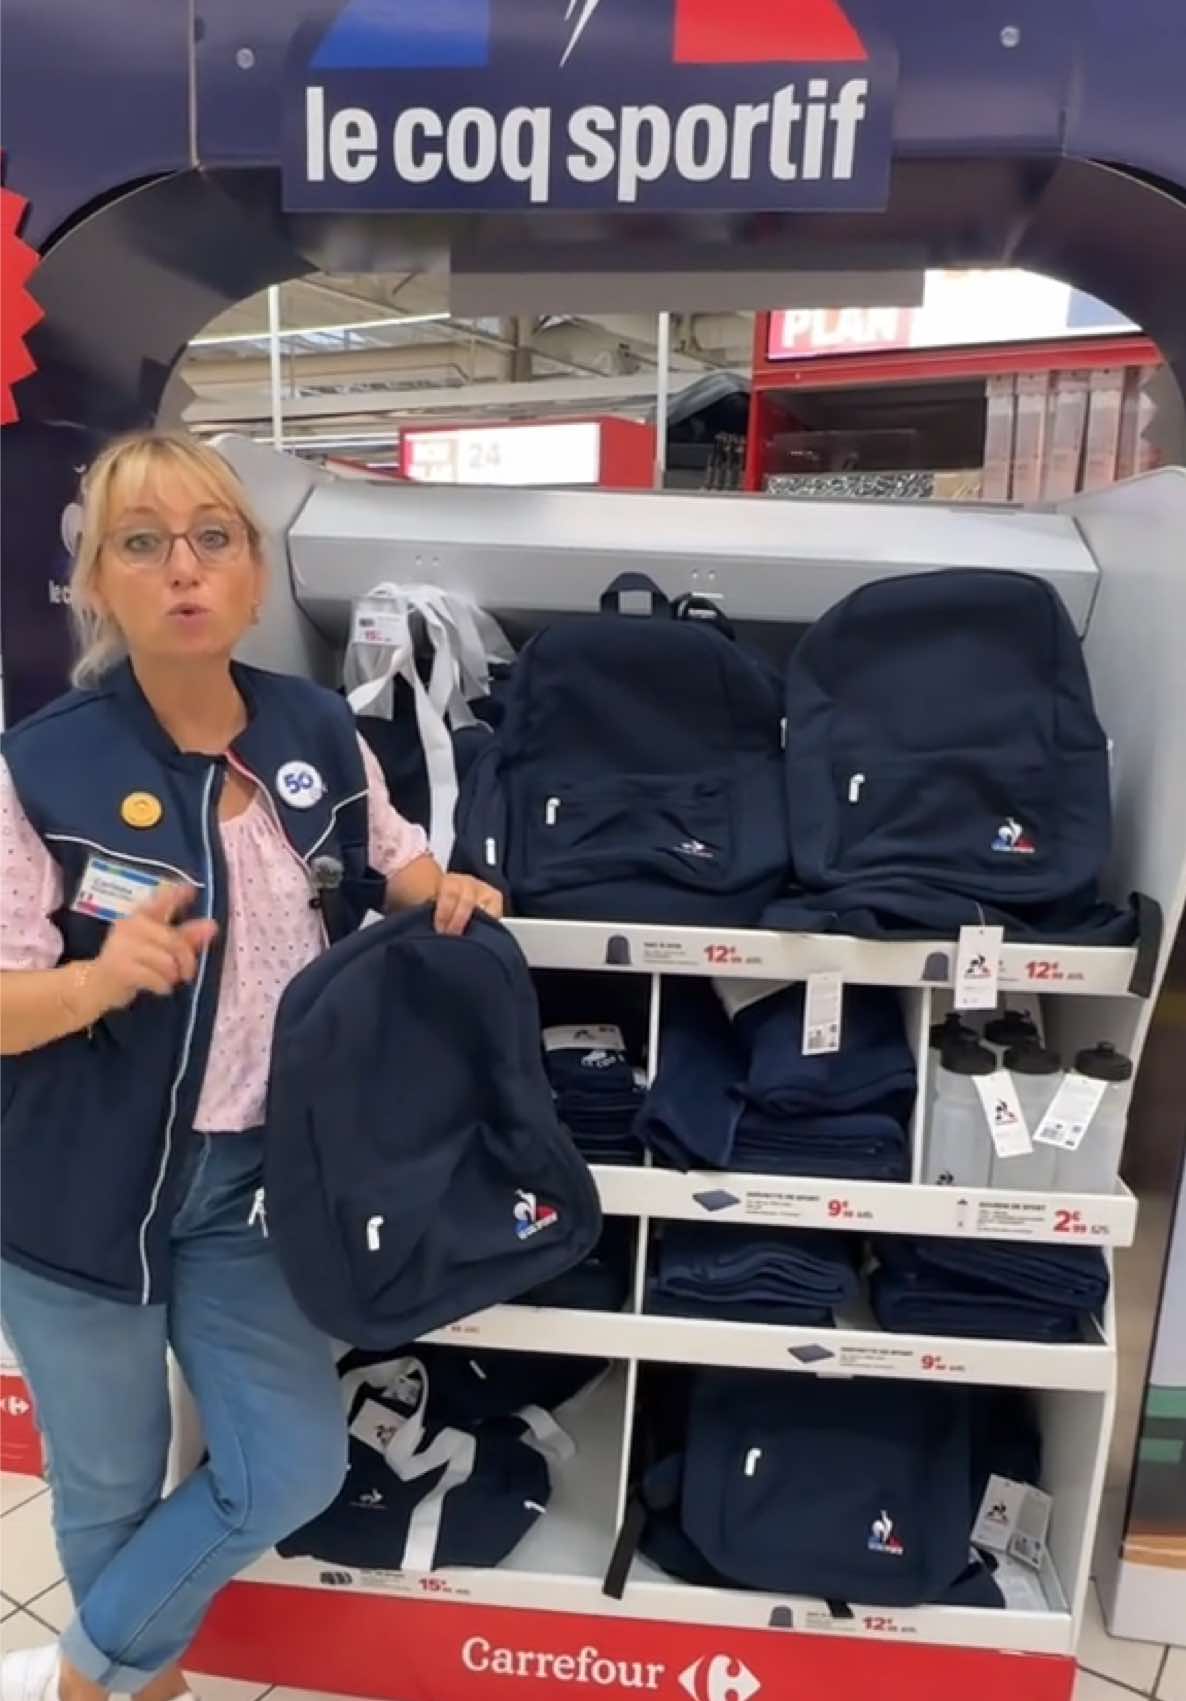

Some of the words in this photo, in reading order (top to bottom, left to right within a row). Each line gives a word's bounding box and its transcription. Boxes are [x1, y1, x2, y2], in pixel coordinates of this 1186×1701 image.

[306, 86, 378, 182] le
[393, 105, 551, 202] coq
[566, 78, 868, 202] sportif
[783, 308, 898, 348] PLAN
[461, 1636, 665, 1689] Carrefour
